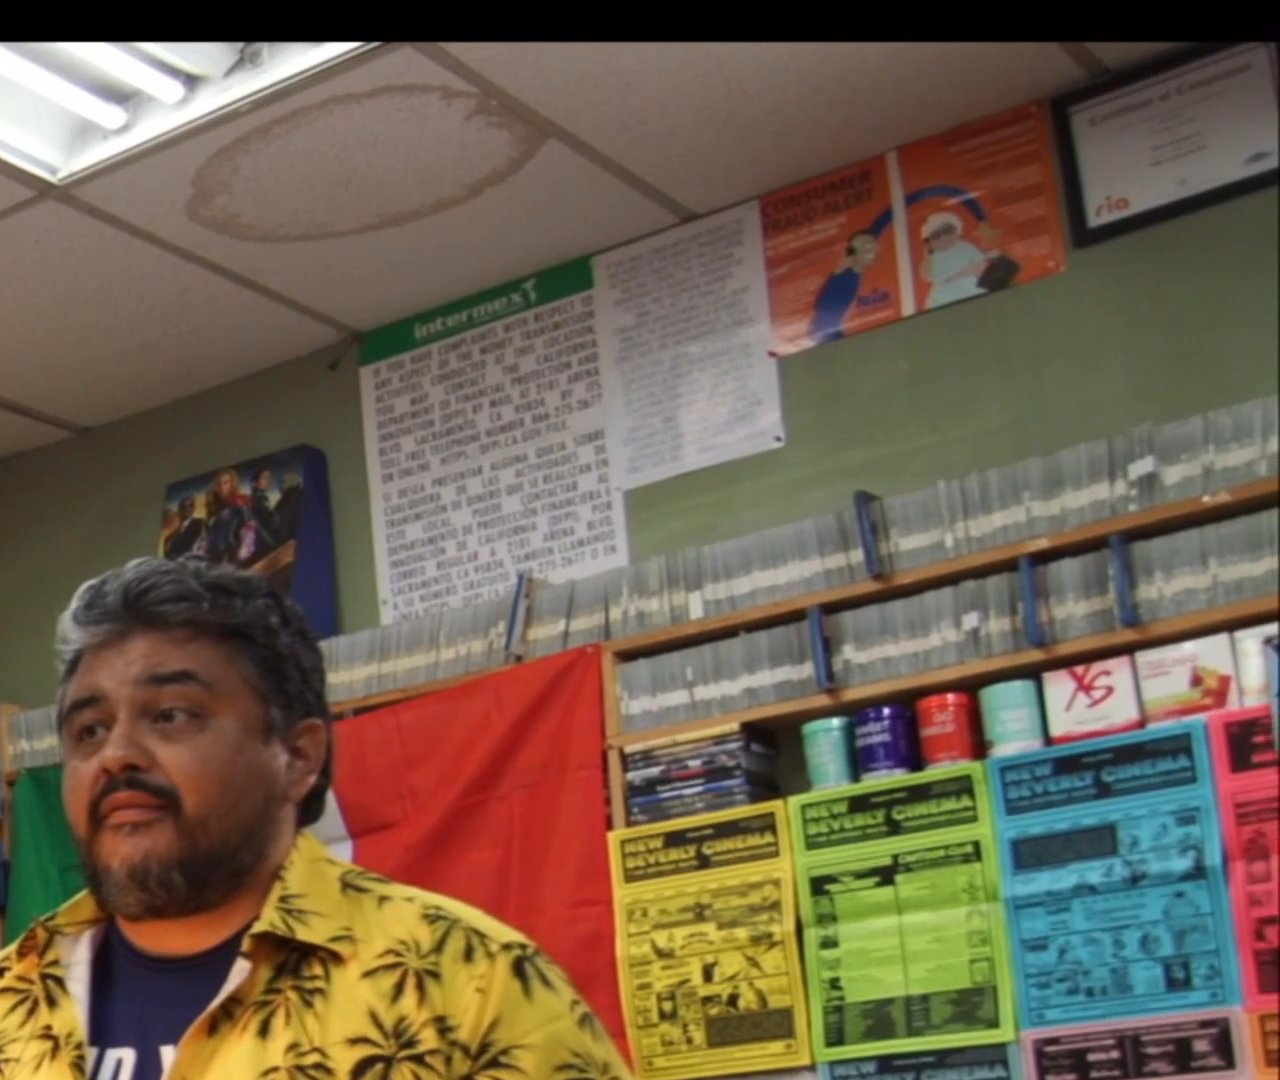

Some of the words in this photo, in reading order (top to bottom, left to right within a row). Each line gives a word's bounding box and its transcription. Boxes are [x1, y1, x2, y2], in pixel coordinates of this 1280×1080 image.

[761, 168, 872, 218] CONSUMER
[1094, 194, 1131, 219] ria
[413, 290, 525, 341] intermex
[444, 372, 486, 395] CONTACT
[502, 361, 519, 377] THE
[535, 336, 597, 366] CALIFORNIA
[376, 403, 434, 431] DEPARTMENT
[438, 397, 451, 411] OF
[454, 380, 504, 406] FINANCIAL
[510, 359, 572, 389] PROTECTION
[1064, 665, 1115, 712] XS
[1004, 763, 1052, 782] NEW
[1006, 770, 1098, 798] BEVERLY
[1099, 754, 1191, 783] CINEMA
[804, 799, 850, 819] NEW
[805, 809, 887, 835] BEVERLY
[892, 793, 974, 819] CINEMA
[624, 837, 665, 855] NEW
[625, 844, 698, 870] BEVERLY
[702, 831, 776, 855] CINEMA
[834, 1059, 878, 1078] NEW
